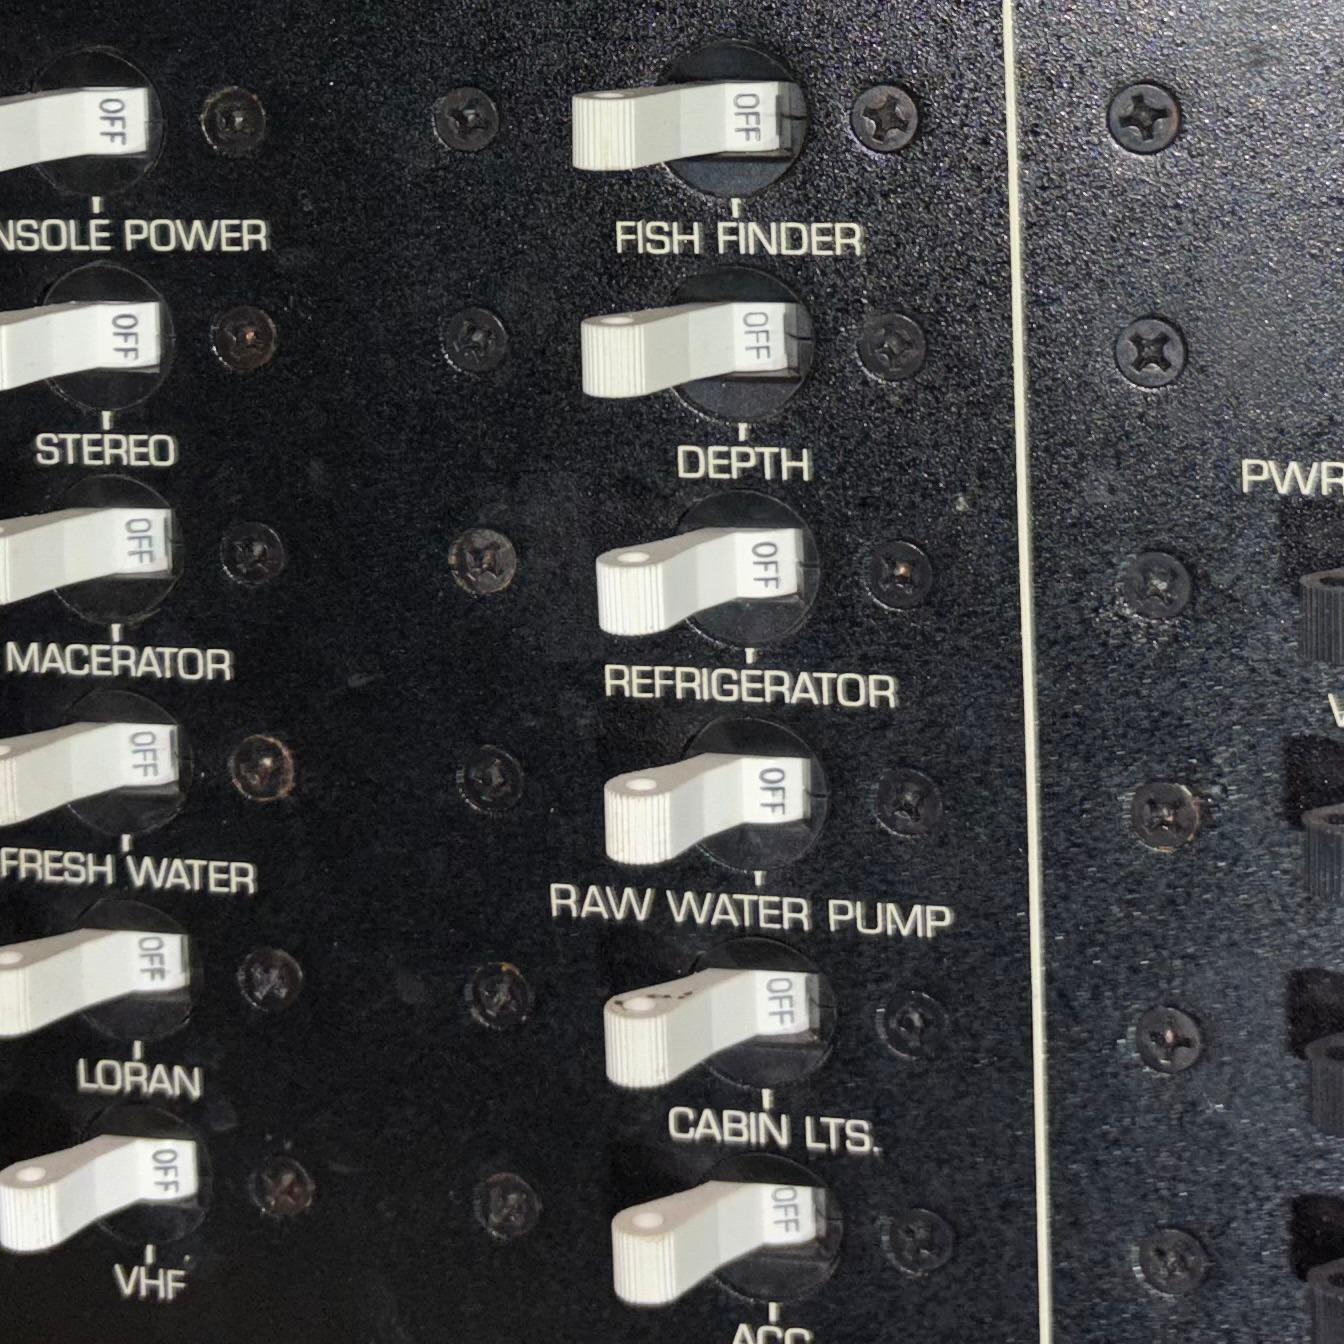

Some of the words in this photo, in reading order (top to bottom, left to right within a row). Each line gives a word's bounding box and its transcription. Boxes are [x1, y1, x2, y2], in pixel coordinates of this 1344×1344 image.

[99, 97, 126, 145] OFF
[733, 93, 762, 142] OFF
[124, 219, 269, 252] POWER
[615, 220, 700, 254] FISH
[717, 222, 864, 257] FINDER
[111, 313, 139, 361] OFF
[742, 311, 771, 360] OFF
[35, 433, 177, 467] STEREO
[677, 445, 811, 481] DEPTH
[124, 518, 154, 564] OFF
[751, 541, 781, 590] OFF
[5, 640, 234, 681] MACERATOR
[605, 664, 897, 708] REFRIGERATOR
[128, 730, 158, 777] OFF
[759, 767, 786, 815] OFF
[125, 855, 255, 894] WATER
[550, 882, 654, 922] RAW
[666, 889, 809, 932] WATER
[828, 899, 953, 939] PUMP
[138, 935, 165, 981] OFF
[766, 977, 795, 1026] OFF
[77, 1058, 203, 1100] LORAN
[668, 1105, 788, 1147] CABIN
[805, 1115, 881, 1154] LTS.
[152, 1148, 180, 1194] OFF
[772, 1185, 800, 1233] OFF
[114, 1263, 189, 1300] VHF
